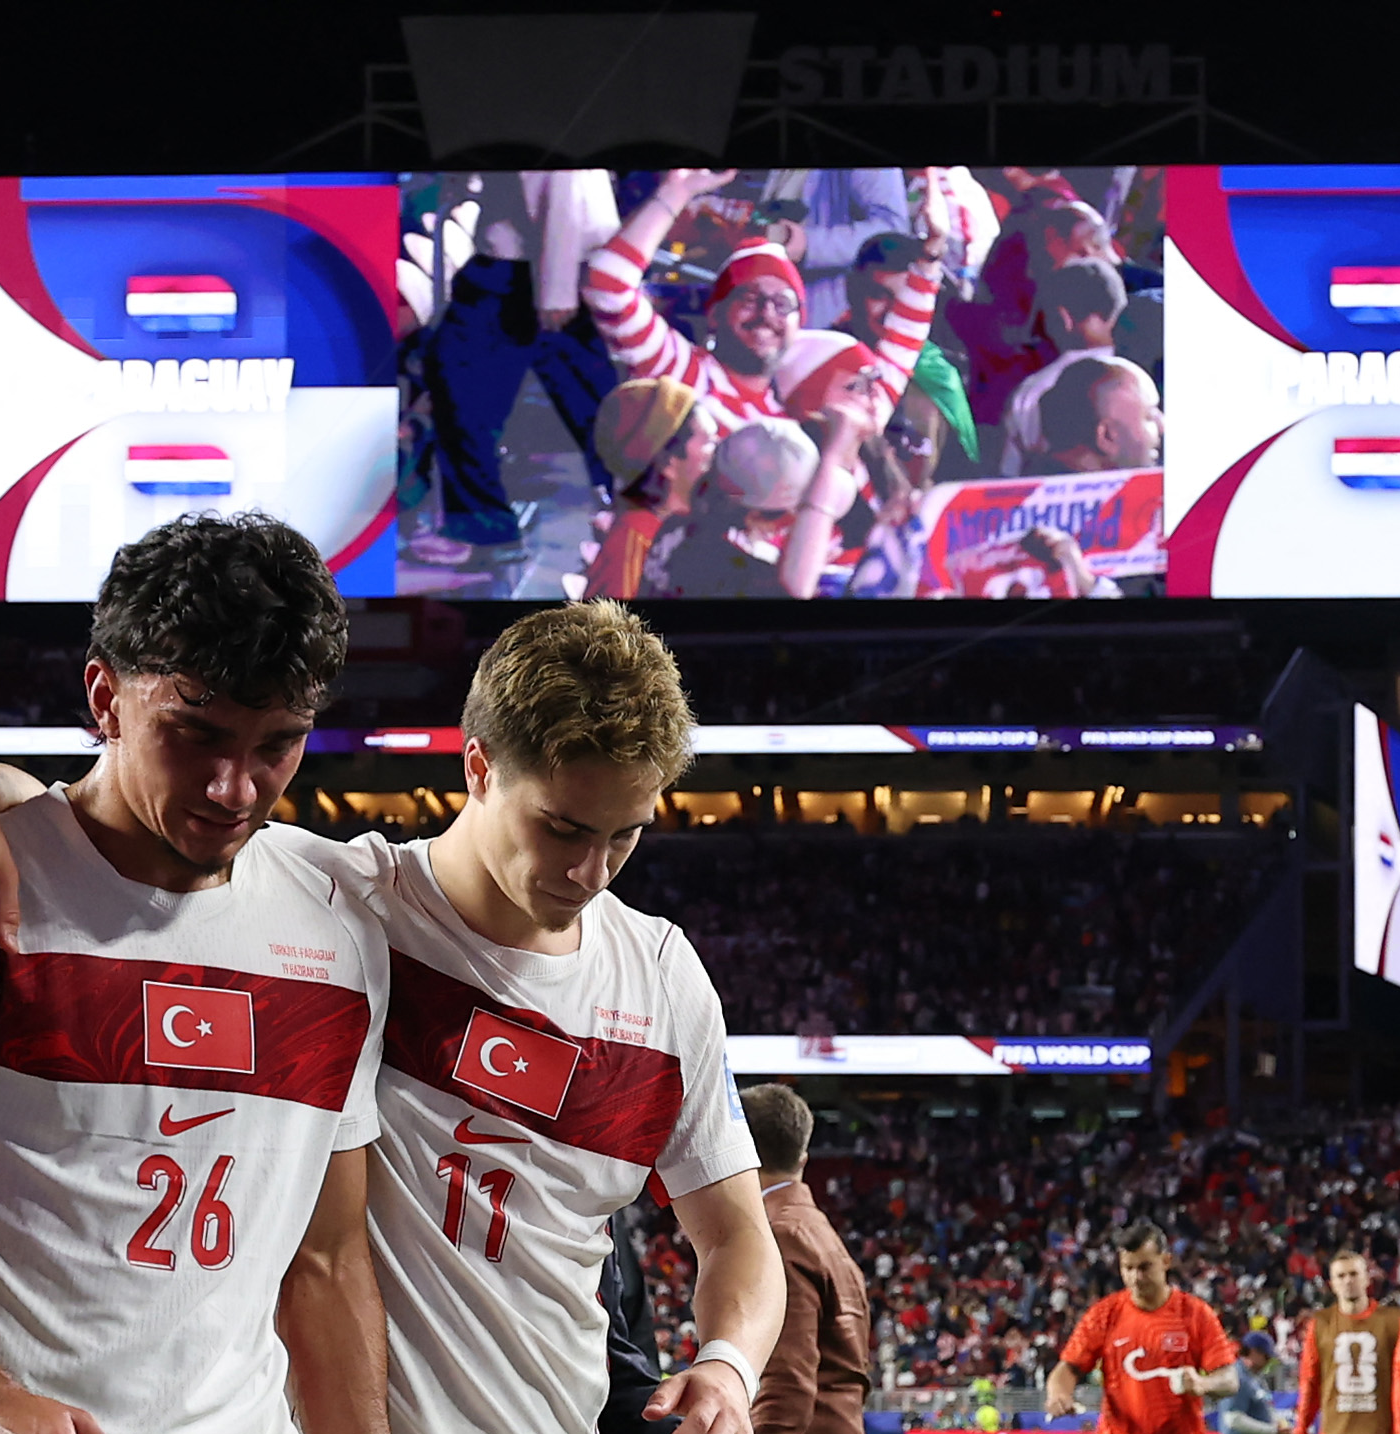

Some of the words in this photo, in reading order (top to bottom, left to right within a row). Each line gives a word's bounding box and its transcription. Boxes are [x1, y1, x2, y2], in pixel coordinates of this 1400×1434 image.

[779, 43, 1171, 101] STADIUM
[1037, 1045, 1109, 1065] WORLD
[1109, 1045, 1151, 1065] CUP
[126, 1153, 236, 1272] 26
[435, 1151, 516, 1264] 11
